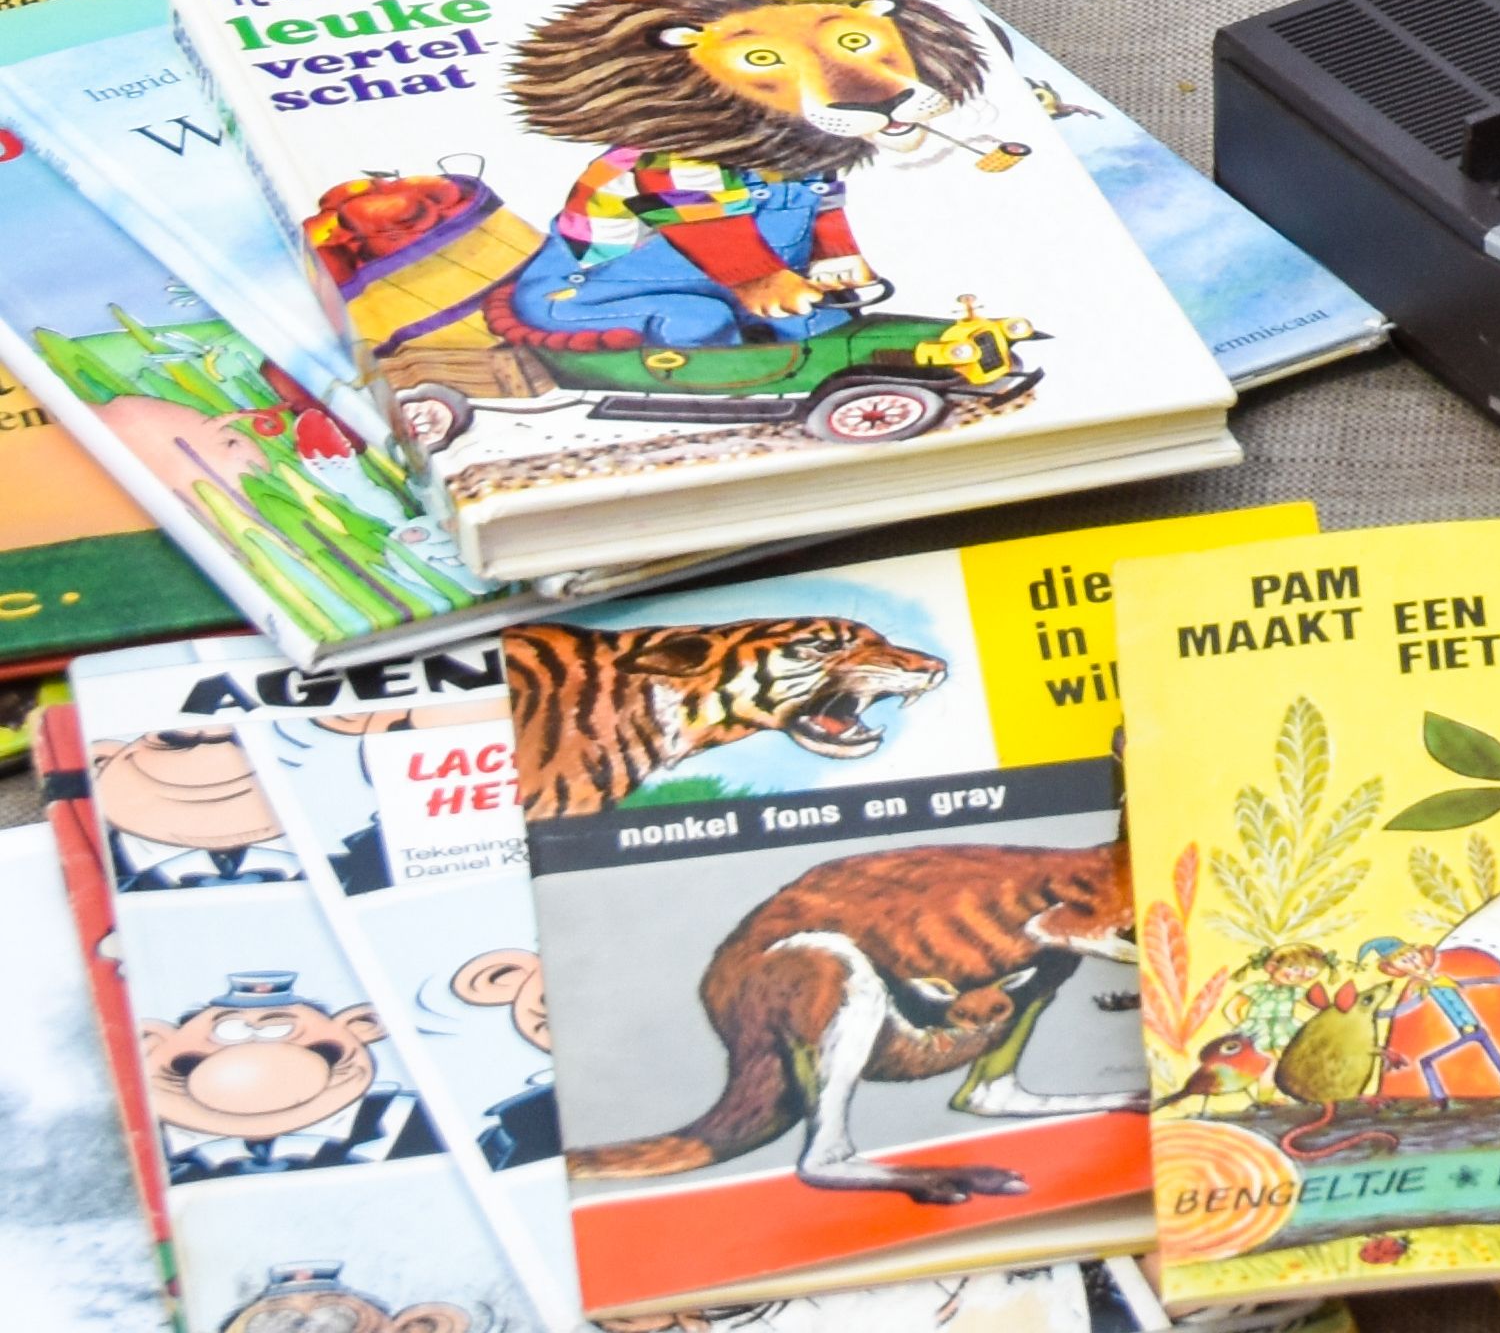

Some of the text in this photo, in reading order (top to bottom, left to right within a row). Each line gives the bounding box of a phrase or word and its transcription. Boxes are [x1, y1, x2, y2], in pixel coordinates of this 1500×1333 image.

[251, 28, 502, 82] vertel-
[84, 68, 182, 104] Ingrid
[271, 63, 477, 113] schat
[1213, 309, 1331, 356] emniscaat
[1030, 565, 1113, 612] die
[1252, 564, 1361, 610] PAM
[1177, 608, 1361, 660] MAAKT
[1394, 595, 1487, 635] EEN
[1036, 621, 1088, 661] in
[408, 743, 520, 781] LAC
[619, 778, 1009, 848] nonkel fons en gray
[405, 856, 490, 879] Daniel
[1174, 1163, 1429, 1216] BENGELTJE
